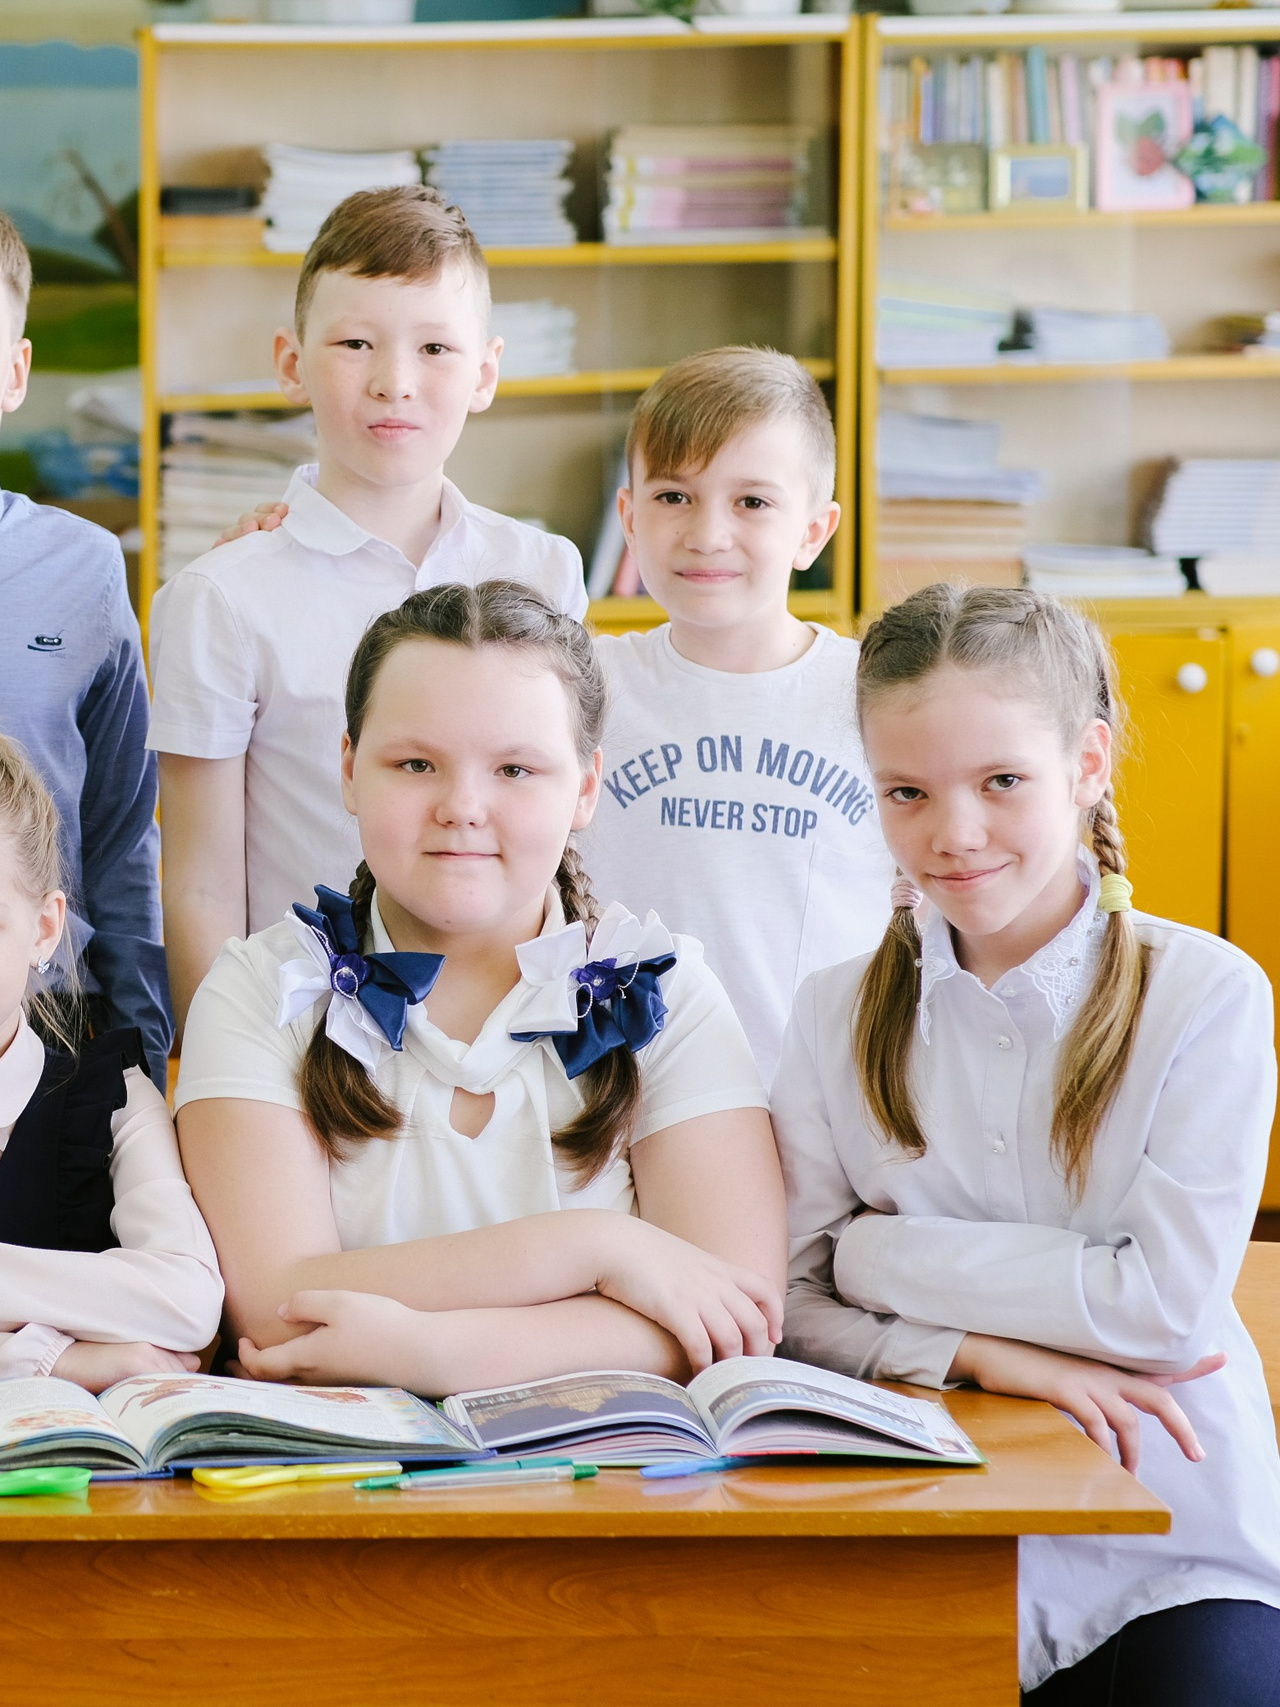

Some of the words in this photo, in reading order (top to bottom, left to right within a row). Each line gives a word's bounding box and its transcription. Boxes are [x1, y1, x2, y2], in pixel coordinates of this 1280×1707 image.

[603, 742, 683, 809] KEEP
[696, 735, 743, 772] ON
[755, 738, 875, 826] MOVING
[660, 796, 745, 831] NEVER
[751, 802, 818, 839] STOP
